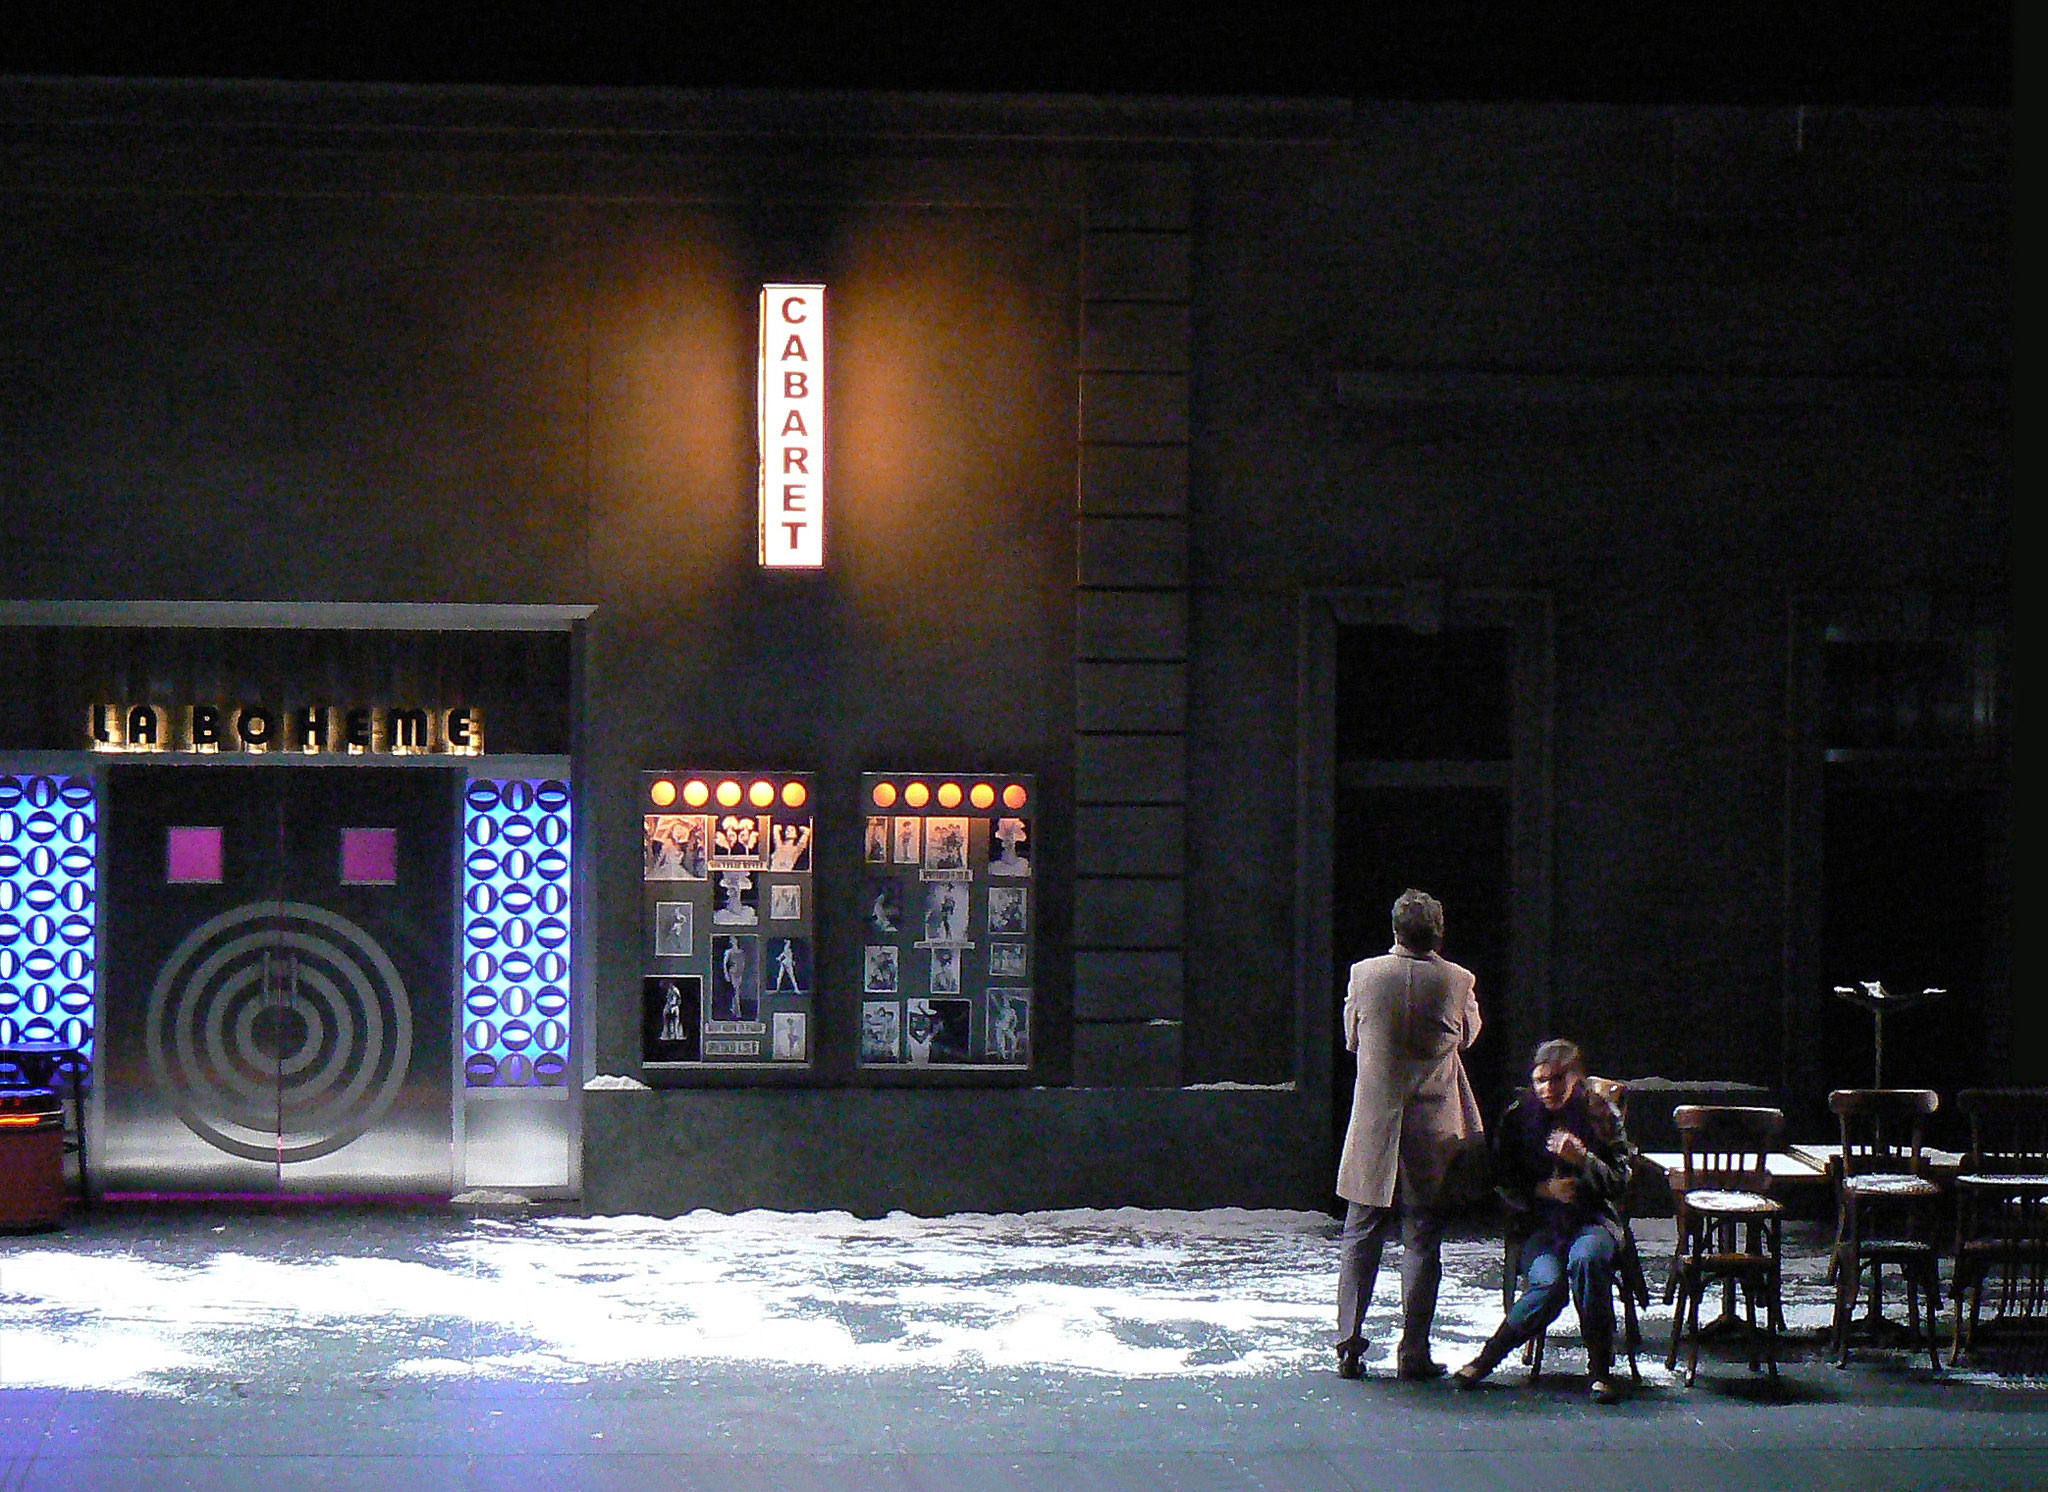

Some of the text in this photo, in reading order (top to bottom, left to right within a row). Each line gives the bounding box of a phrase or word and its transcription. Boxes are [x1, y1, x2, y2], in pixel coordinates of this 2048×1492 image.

[781, 296, 809, 550] CABARET
[93, 705, 472, 747] LA BOHEME
